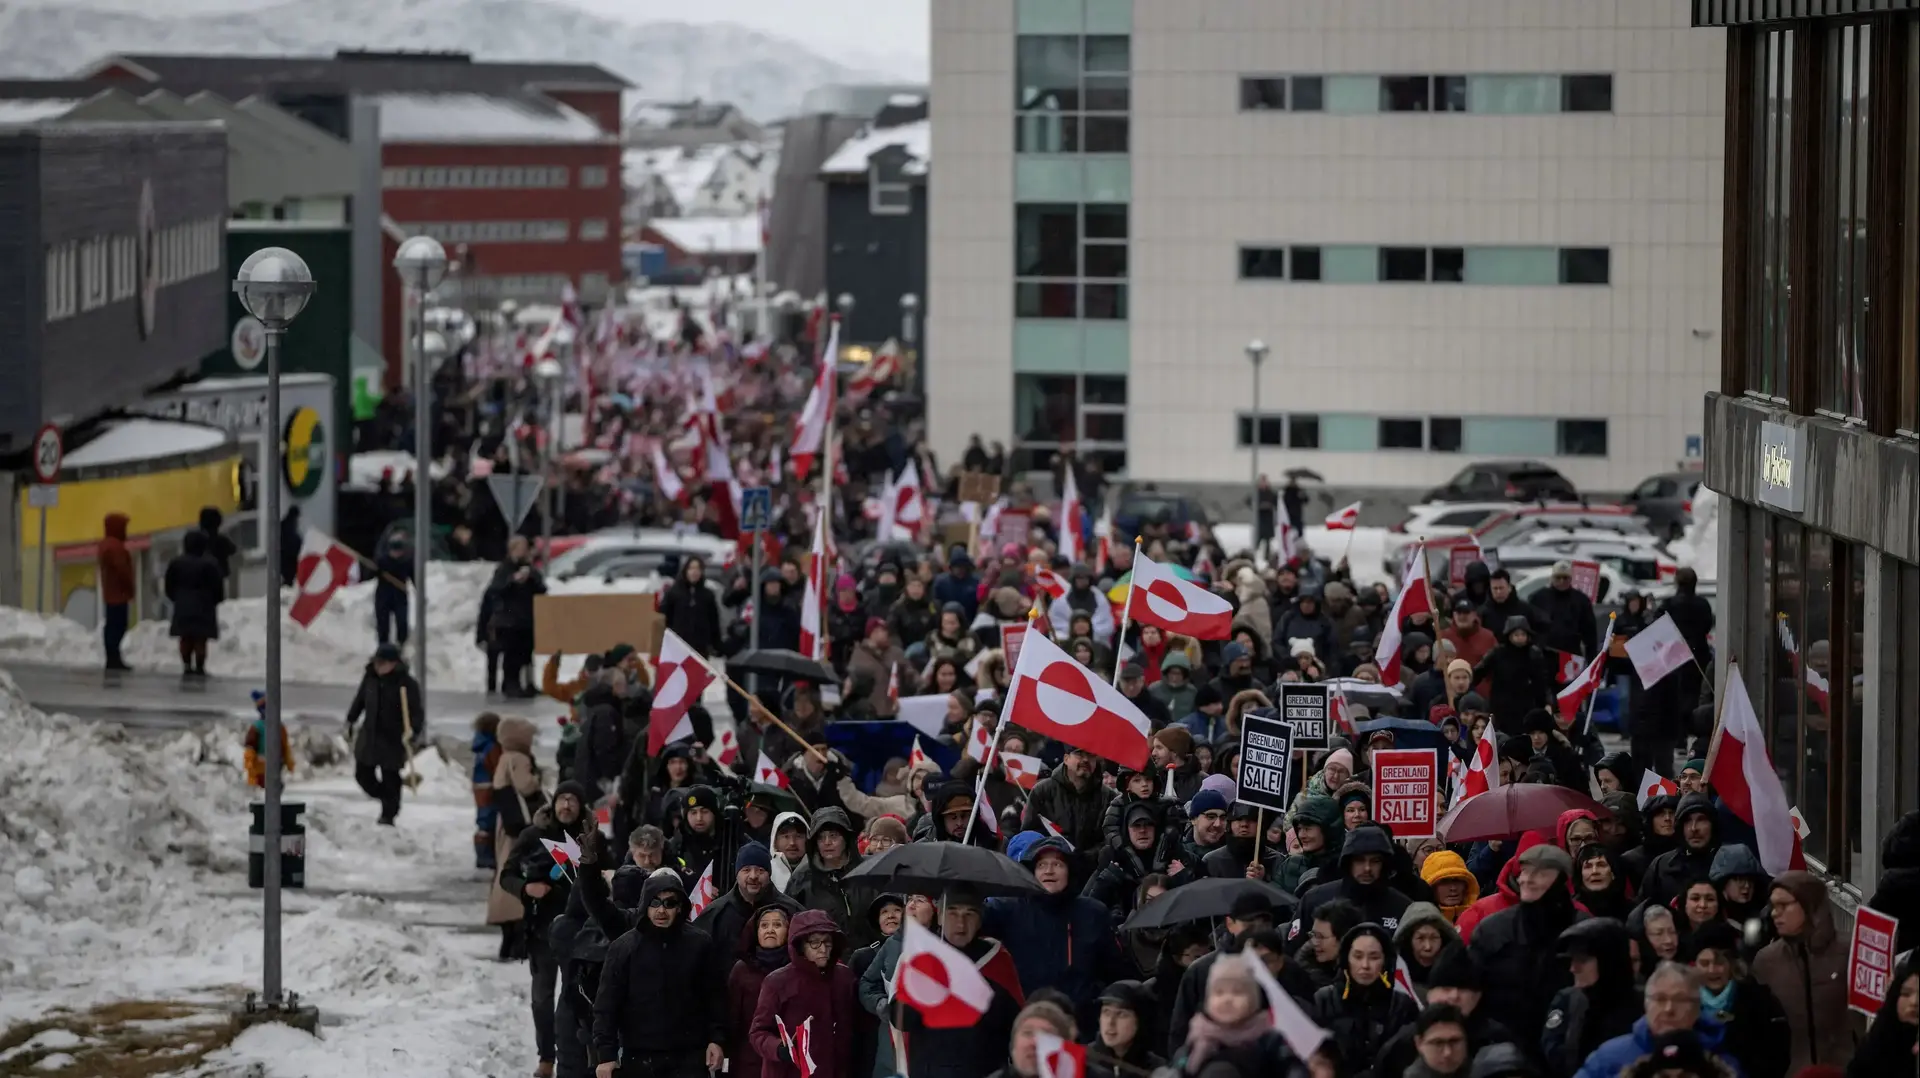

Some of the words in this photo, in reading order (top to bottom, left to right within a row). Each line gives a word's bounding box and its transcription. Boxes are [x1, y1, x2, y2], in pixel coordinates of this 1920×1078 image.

[40, 440, 59, 465] 20
[1288, 696, 1322, 705] GREENLAND
[1288, 708, 1294, 717] IS
[1296, 708, 1308, 717] NOT
[1310, 708, 1322, 717] FOR
[1249, 732, 1285, 750] GREENLAND
[1247, 749, 1254, 760] IS
[1256, 751, 1268, 763] NOT
[1270, 754, 1283, 767] FOR
[1245, 765, 1281, 794] SALE!
[1382, 767, 1428, 778] GREENLAND
[1382, 784, 1390, 795] IS
[1394, 784, 1409, 794] NOT
[1412, 784, 1428, 794] FOR
[1382, 800, 1427, 822] SALE!
[1856, 966, 1886, 998] SALE!
